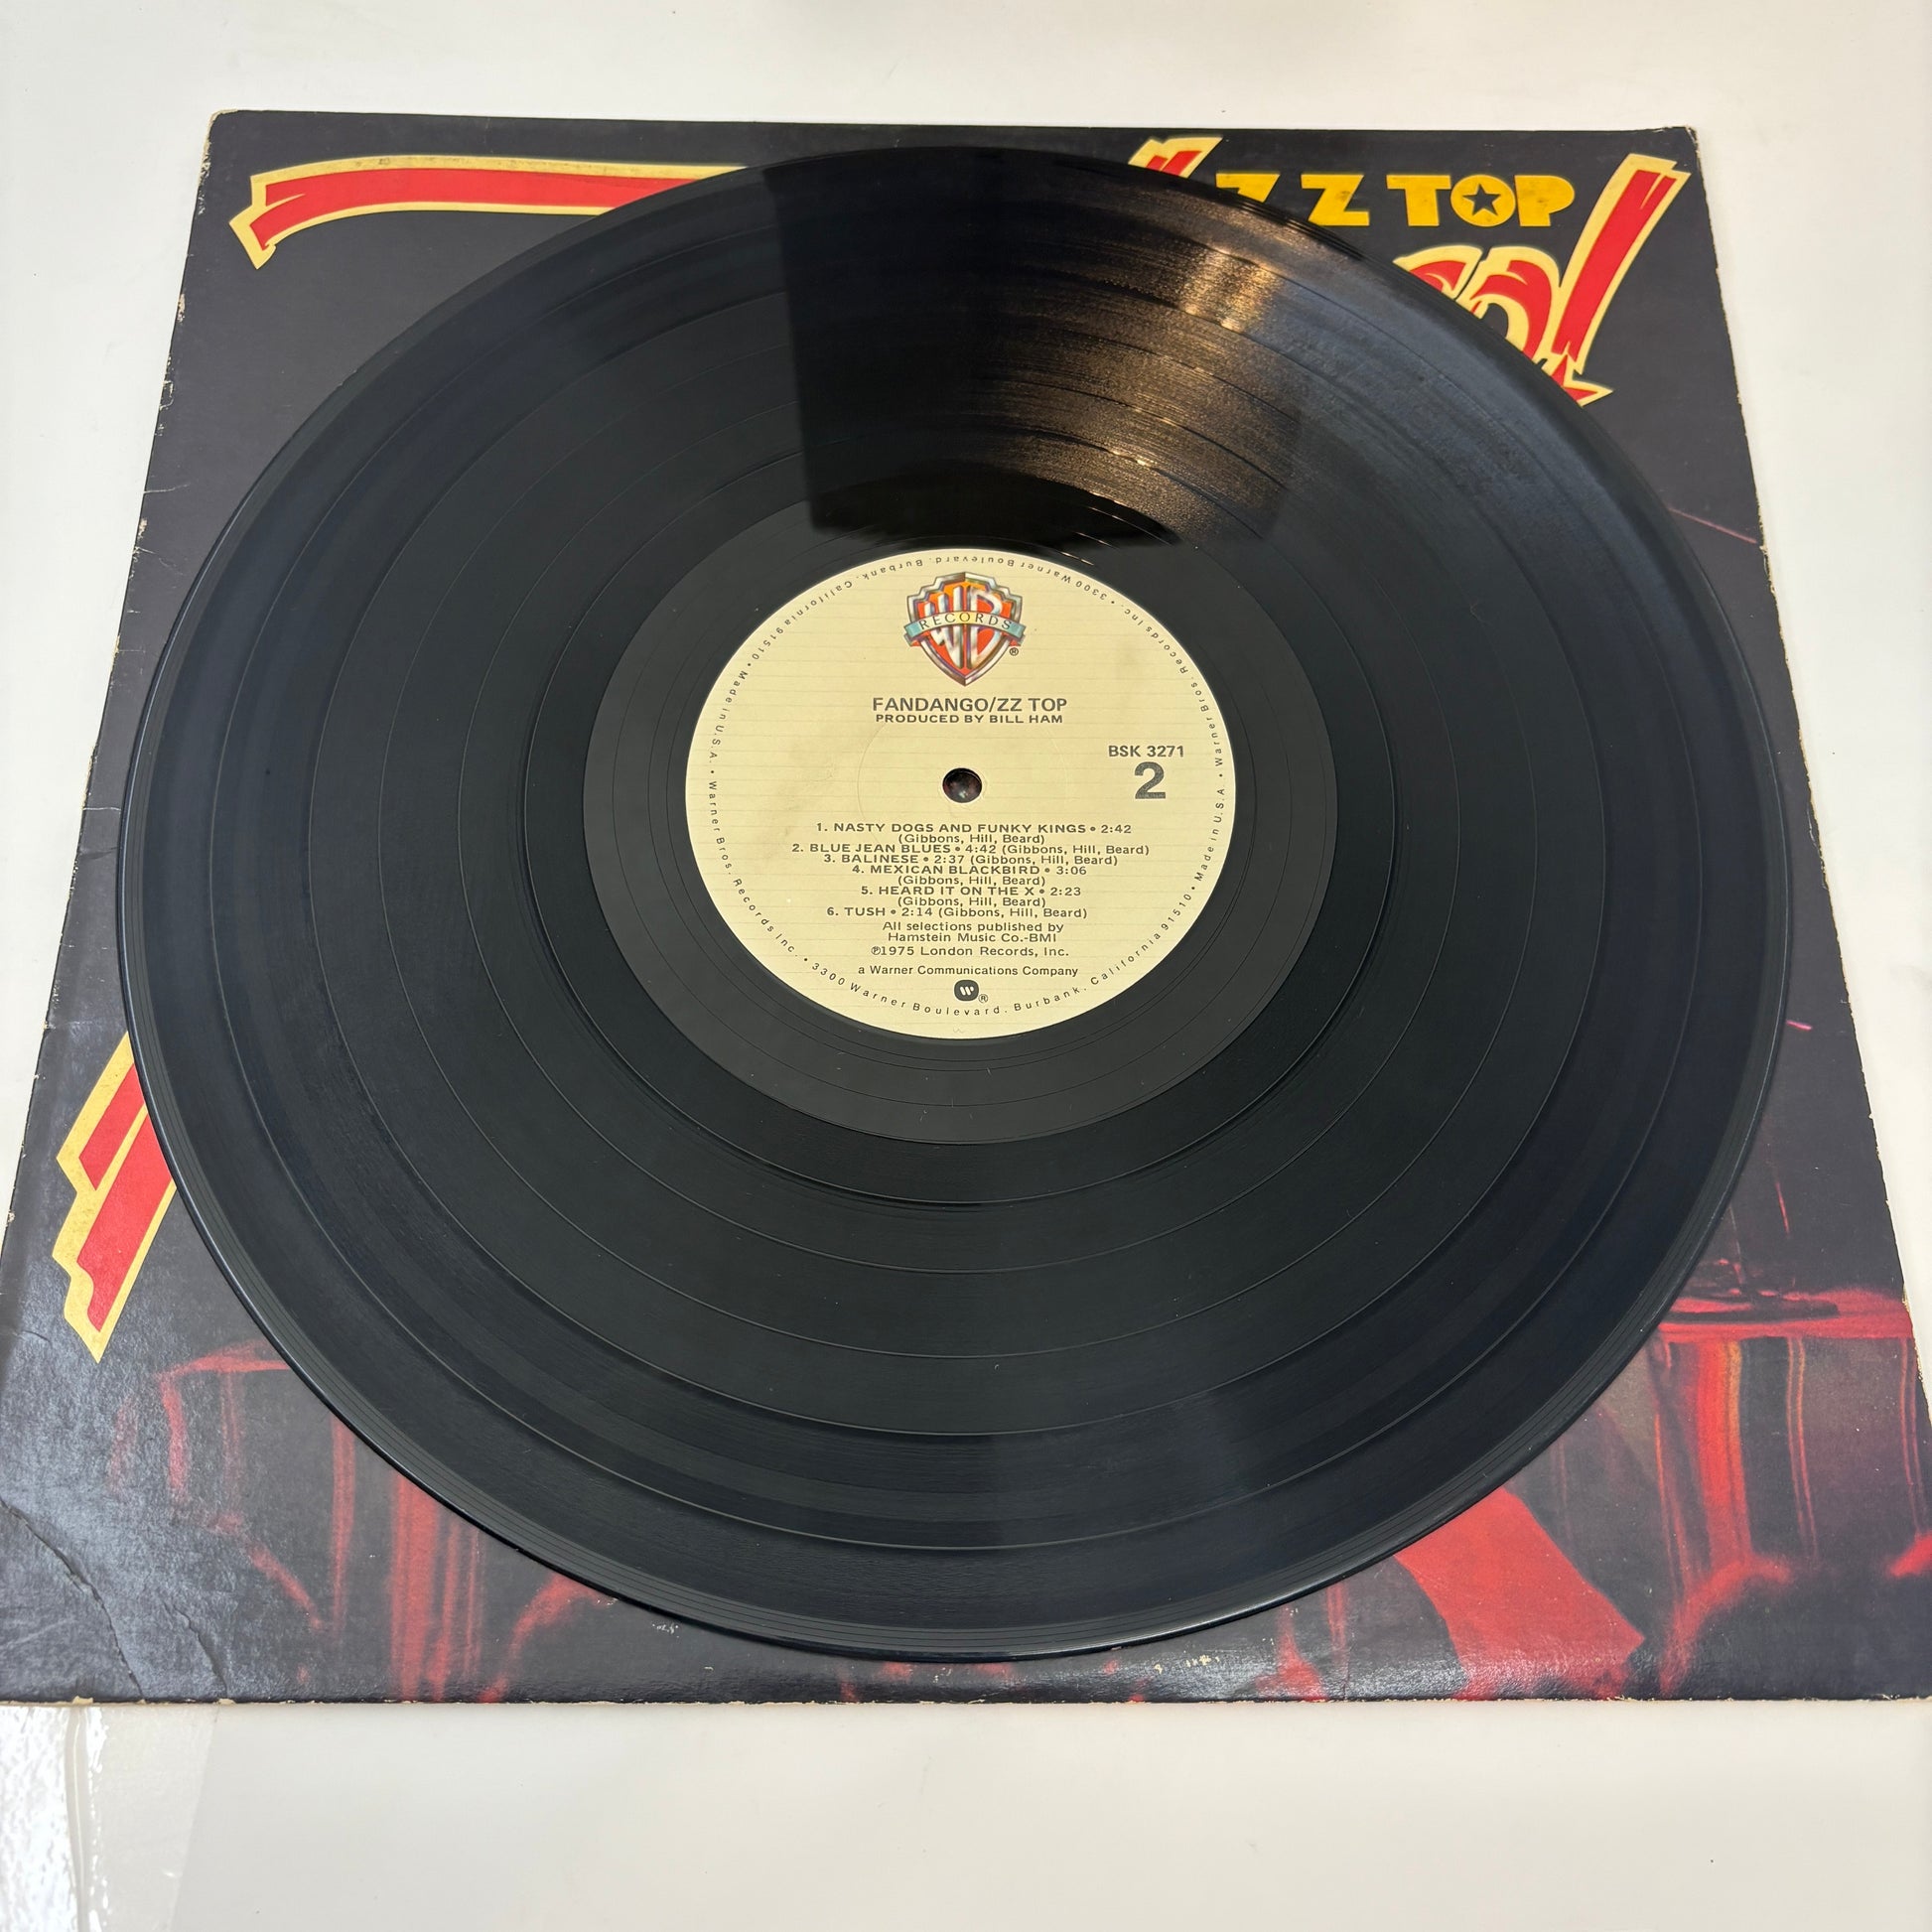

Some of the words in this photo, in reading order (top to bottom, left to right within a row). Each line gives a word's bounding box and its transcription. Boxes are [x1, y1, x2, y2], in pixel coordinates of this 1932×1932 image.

[1387, 174, 1575, 227] TOP
[1021, 561, 1071, 584] Warner
[1075, 580, 1107, 601] 3300
[784, 580, 853, 626] California
[918, 613, 1012, 629] RECORDS
[752, 627, 784, 660] 91510
[1146, 625, 1188, 675] Records
[725, 670, 749, 704] Made
[1190, 676, 1209, 712] Bros.
[874, 697, 1022, 712] FANDANGO/ZZ
[1028, 698, 1066, 711] TOP
[877, 714, 959, 723] PRODUCED
[709, 725, 724, 763] U.S.A.
[1109, 746, 1141, 757] BSK
[1147, 746, 1183, 758] 3271
[1206, 717, 1223, 767] Warner
[1134, 760, 1167, 799] 2
[709, 781, 720, 831] Warner
[1213, 784, 1225, 823] U.S.A.
[834, 823, 885, 832] NASTY
[978, 824, 1032, 833] FUNKY
[1038, 824, 1086, 833] KINGS
[1211, 828, 1219, 842] in
[856, 844, 895, 853] JEAN
[965, 845, 996, 854] 4:42
[1003, 845, 1067, 855] (Gibbons,
[1073, 845, 1100, 855] Hill,
[1106, 845, 1149, 856] Beard)
[898, 834, 963, 844] (Gibbons,
[970, 834, 997, 844] Hill,
[1003, 834, 1044, 845] Beard)
[716, 837, 732, 875] Bros.
[824, 854, 835, 863] 3.
[934, 855, 964, 864] 2:37
[971, 855, 1035, 865] (Gibbons,
[1041, 855, 1068, 866] Hill,
[1074, 856, 1117, 866] Beard)
[1194, 846, 1214, 883] Made
[871, 865, 942, 874] MEXICAN
[949, 866, 1039, 875] BLACKBIRD
[1056, 866, 1086, 875] 3:06
[862, 886, 873, 895] 5.
[960, 887, 982, 896] ON
[987, 887, 1019, 896] THE
[1025, 887, 1034, 896] X
[898, 876, 963, 886] (Gibbons,
[969, 876, 996, 886] Hill,
[1003, 877, 1045, 887] Beard)
[733, 878, 774, 932] Records
[844, 907, 885, 916] TUSH
[901, 907, 932, 916] 2:14
[939, 907, 1004, 918] (Gibbons,
[1010, 908, 1037, 918] Hill,
[1043, 908, 1087, 918] Beard)
[898, 897, 963, 907] (Gibbons,
[969, 897, 997, 907] Hill,
[1003, 897, 1045, 907] Beard)
[1161, 893, 1192, 931] 91510
[883, 921, 900, 930] All
[906, 922, 972, 931] selections
[978, 922, 1041, 932] published
[1048, 923, 1063, 933] by
[889, 932, 951, 941] Hamstein
[958, 933, 996, 942] Music
[1001, 933, 1055, 942] Co.-BMI
[921, 946, 972, 955] London
[980, 946, 1037, 957] Records,
[1044, 947, 1068, 956] Inc.
[1090, 932, 1161, 985] California
[812, 963, 846, 986] 3300
[917, 965, 1018, 975] Communications
[1023, 966, 1078, 977] Company
[850, 982, 906, 1008] Warner
